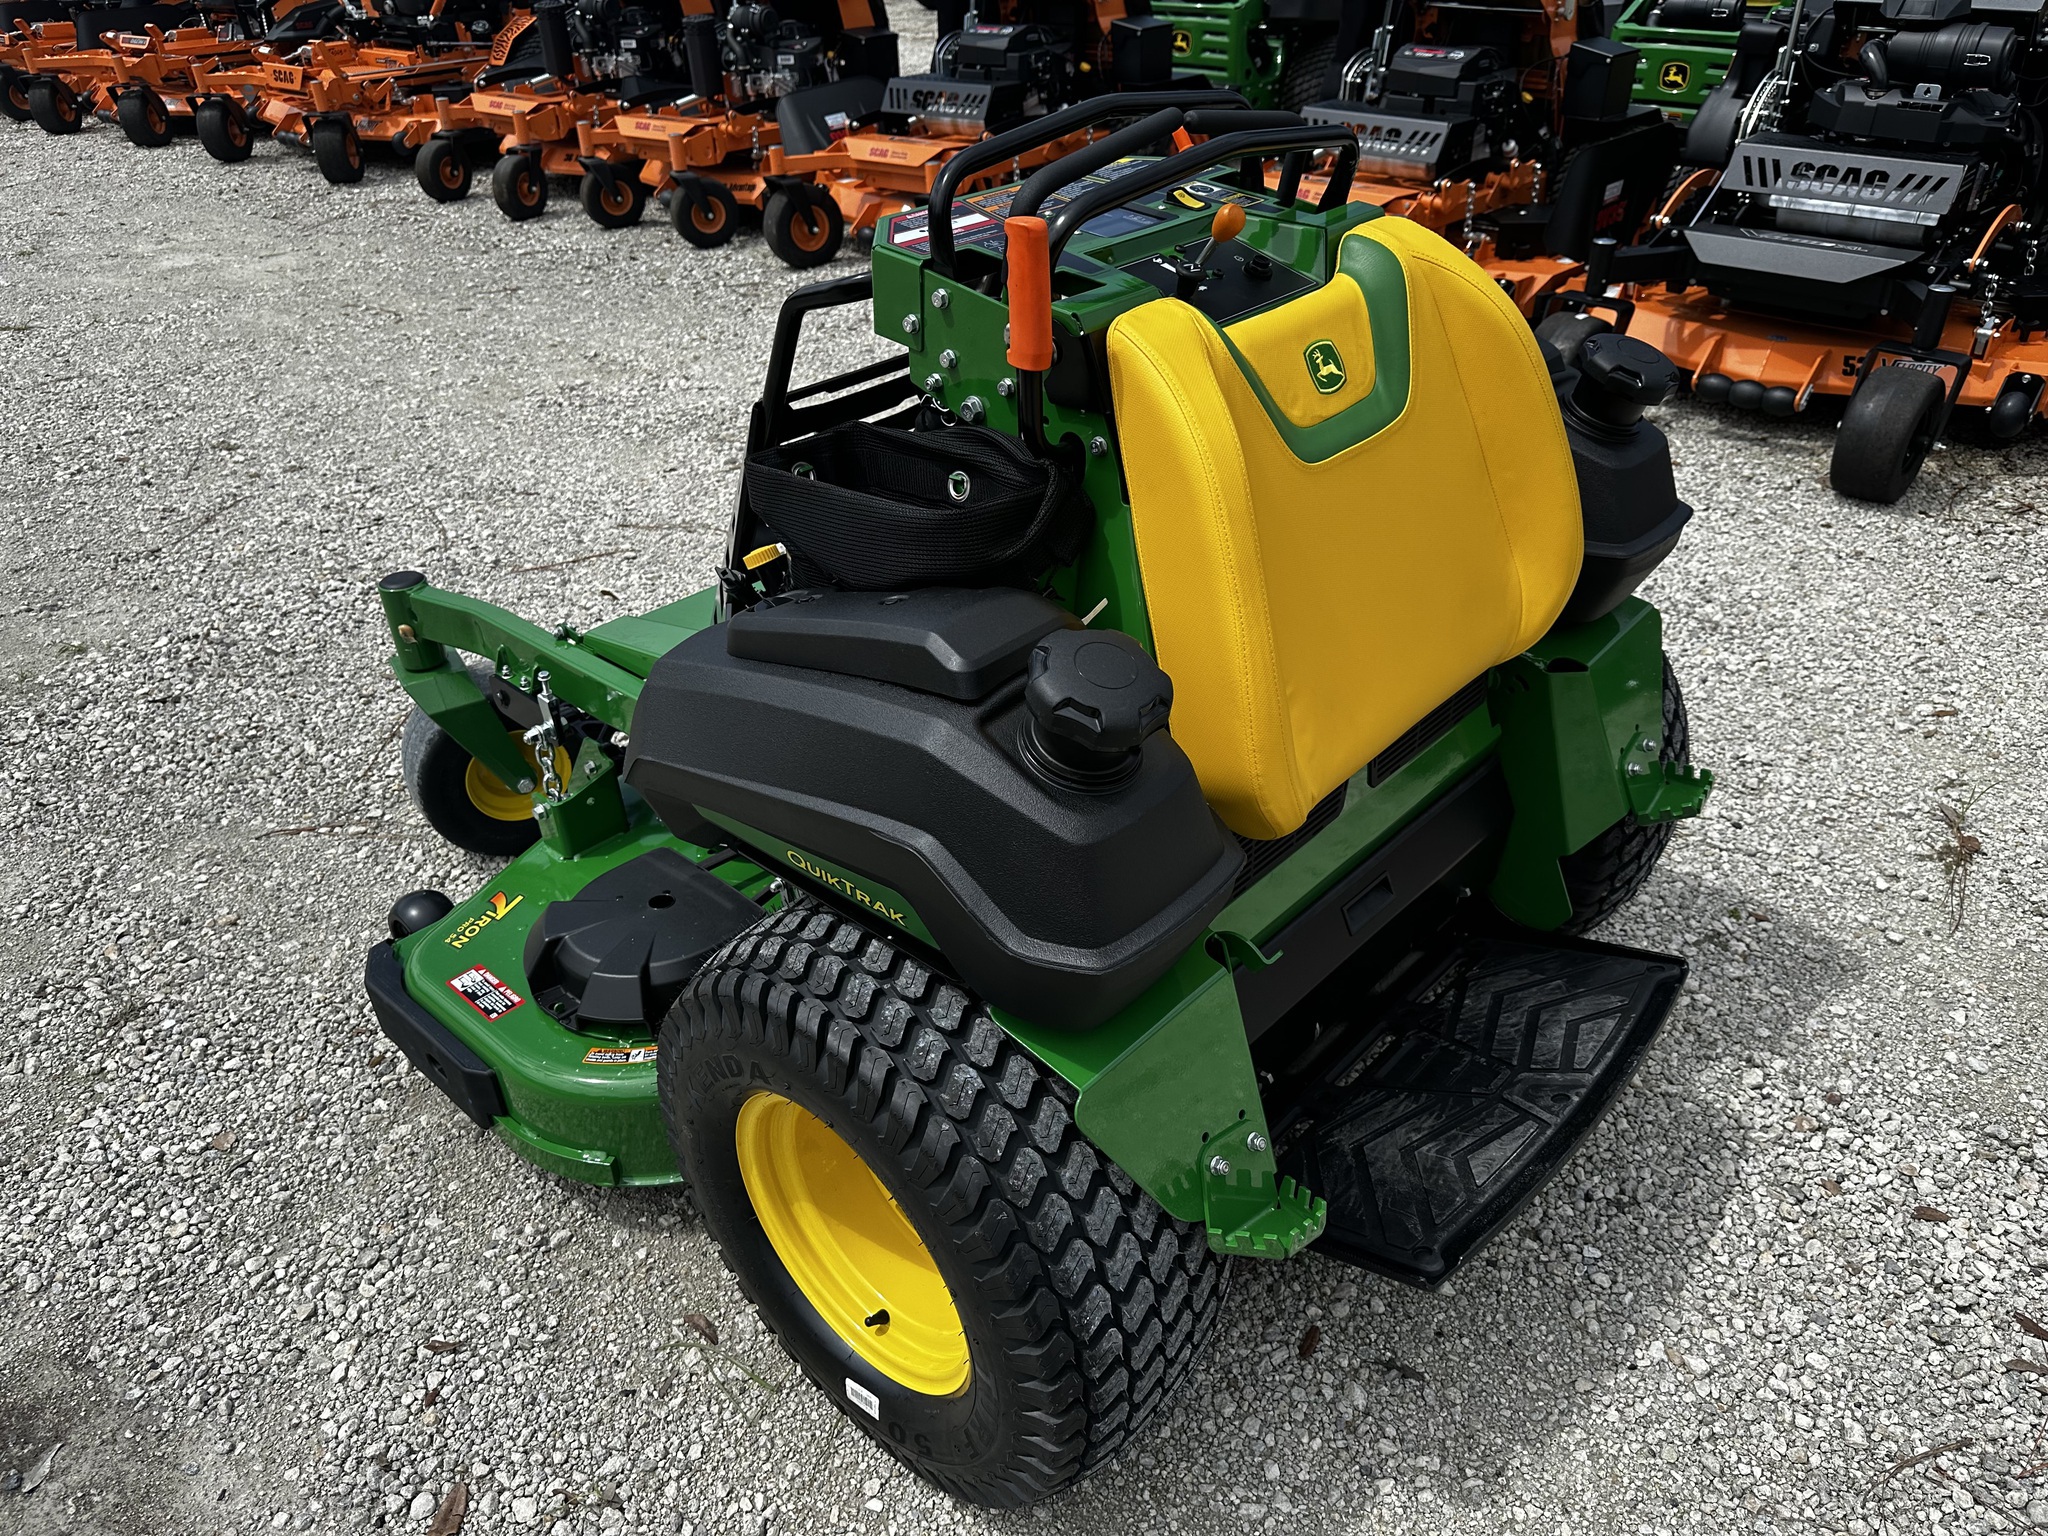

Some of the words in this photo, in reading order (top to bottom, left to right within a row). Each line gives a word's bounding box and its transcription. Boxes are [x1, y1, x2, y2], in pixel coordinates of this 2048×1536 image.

[273, 69, 294, 84] SCAG
[912, 90, 959, 113] SCAG
[869, 147, 889, 159] SCAG
[1787, 161, 1891, 200] SCAG
[786, 850, 906, 926] QUIKTRAK
[456, 917, 475, 932] PRO
